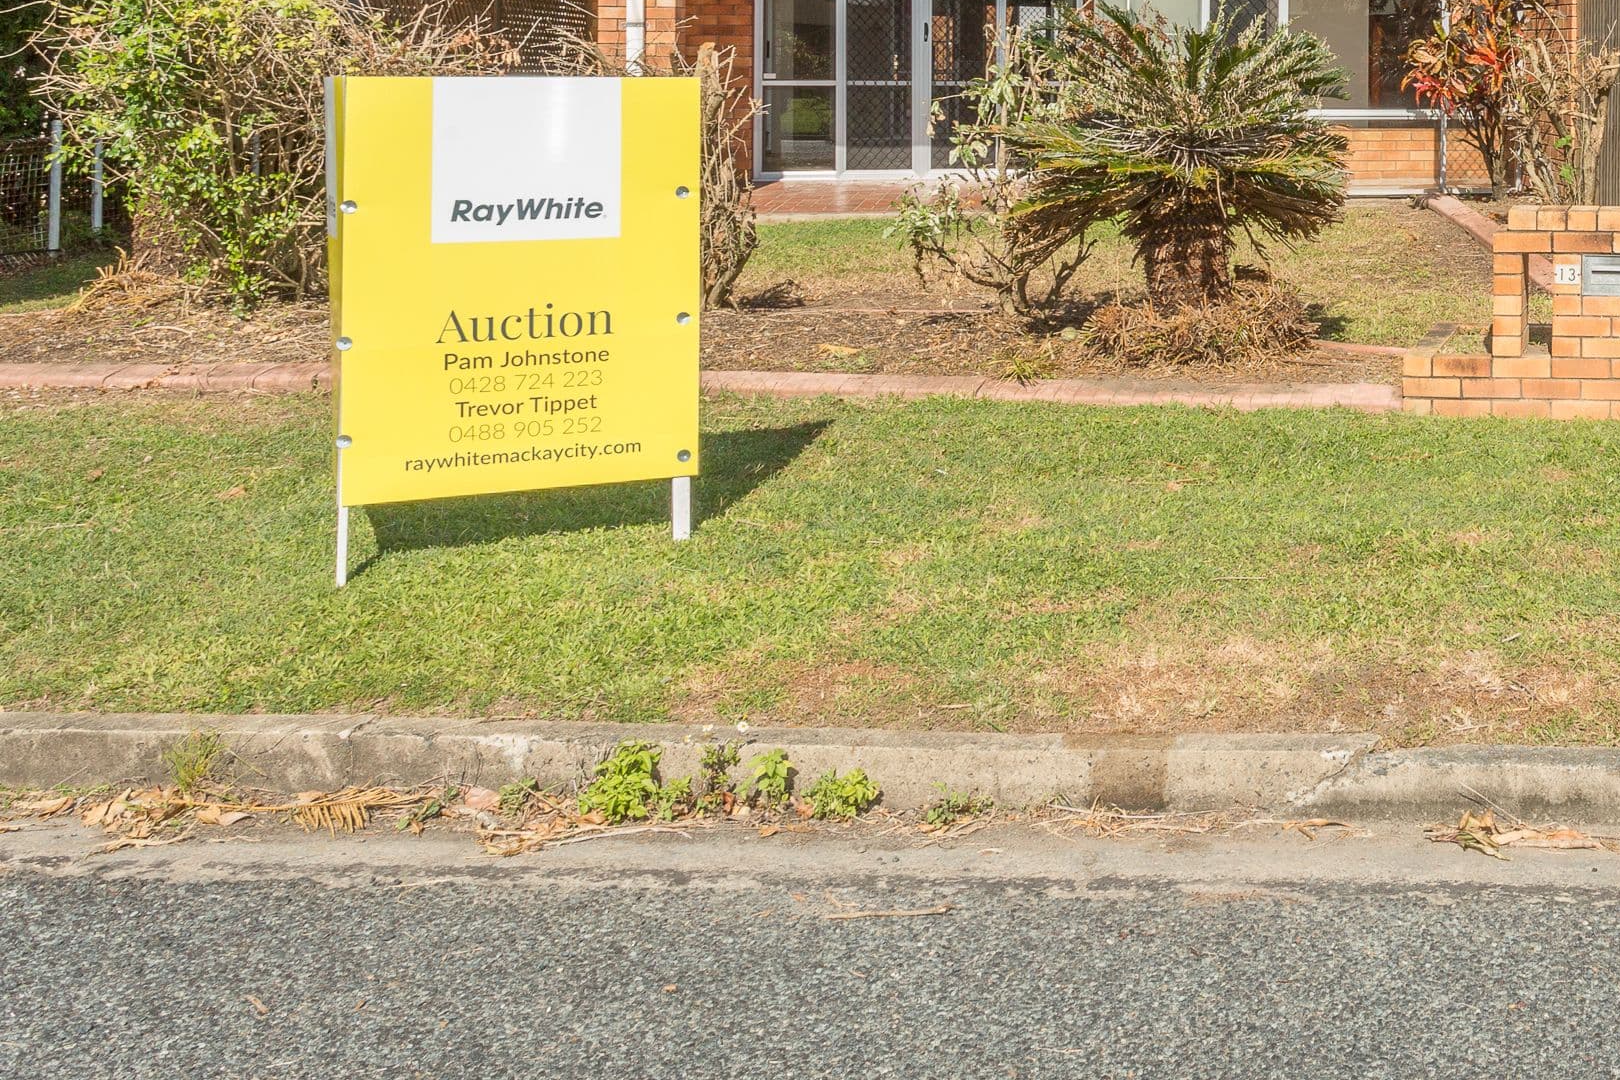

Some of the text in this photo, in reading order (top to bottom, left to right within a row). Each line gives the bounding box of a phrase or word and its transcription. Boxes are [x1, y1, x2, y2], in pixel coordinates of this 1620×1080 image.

[1559, 267, 1577, 282] 13
[435, 303, 614, 344] Auction
[444, 350, 610, 370] Pam Johnstone
[449, 370, 603, 394] 0428 724 223
[455, 394, 598, 418] Trevor Tippet
[448, 416, 602, 443] 0488 905 252
[405, 441, 641, 473] raywhitemackaycity.com
